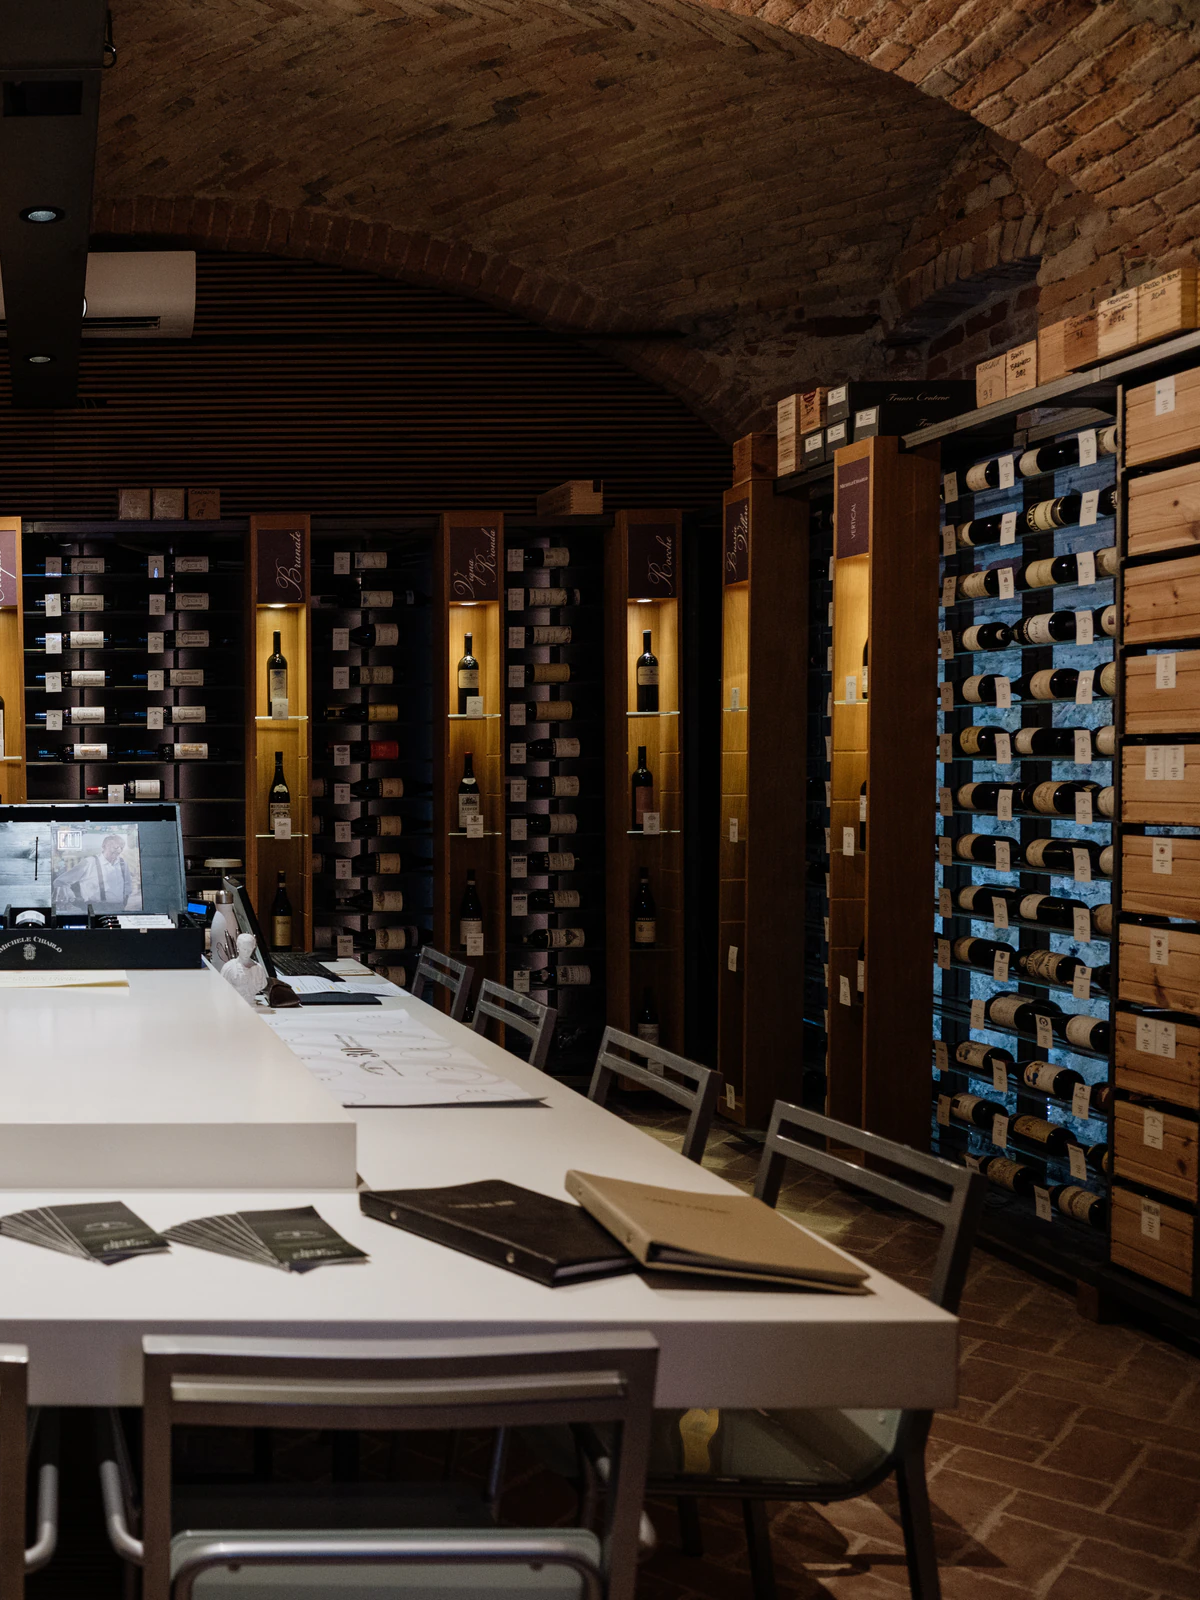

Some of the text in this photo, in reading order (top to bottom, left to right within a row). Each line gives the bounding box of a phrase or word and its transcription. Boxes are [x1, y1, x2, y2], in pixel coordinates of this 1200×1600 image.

[275, 530, 302, 600] Brunate
[453, 527, 498, 599] Vigna Rionda
[647, 535, 672, 596] Rocche
[33, 936, 63, 953] CHIARLO
